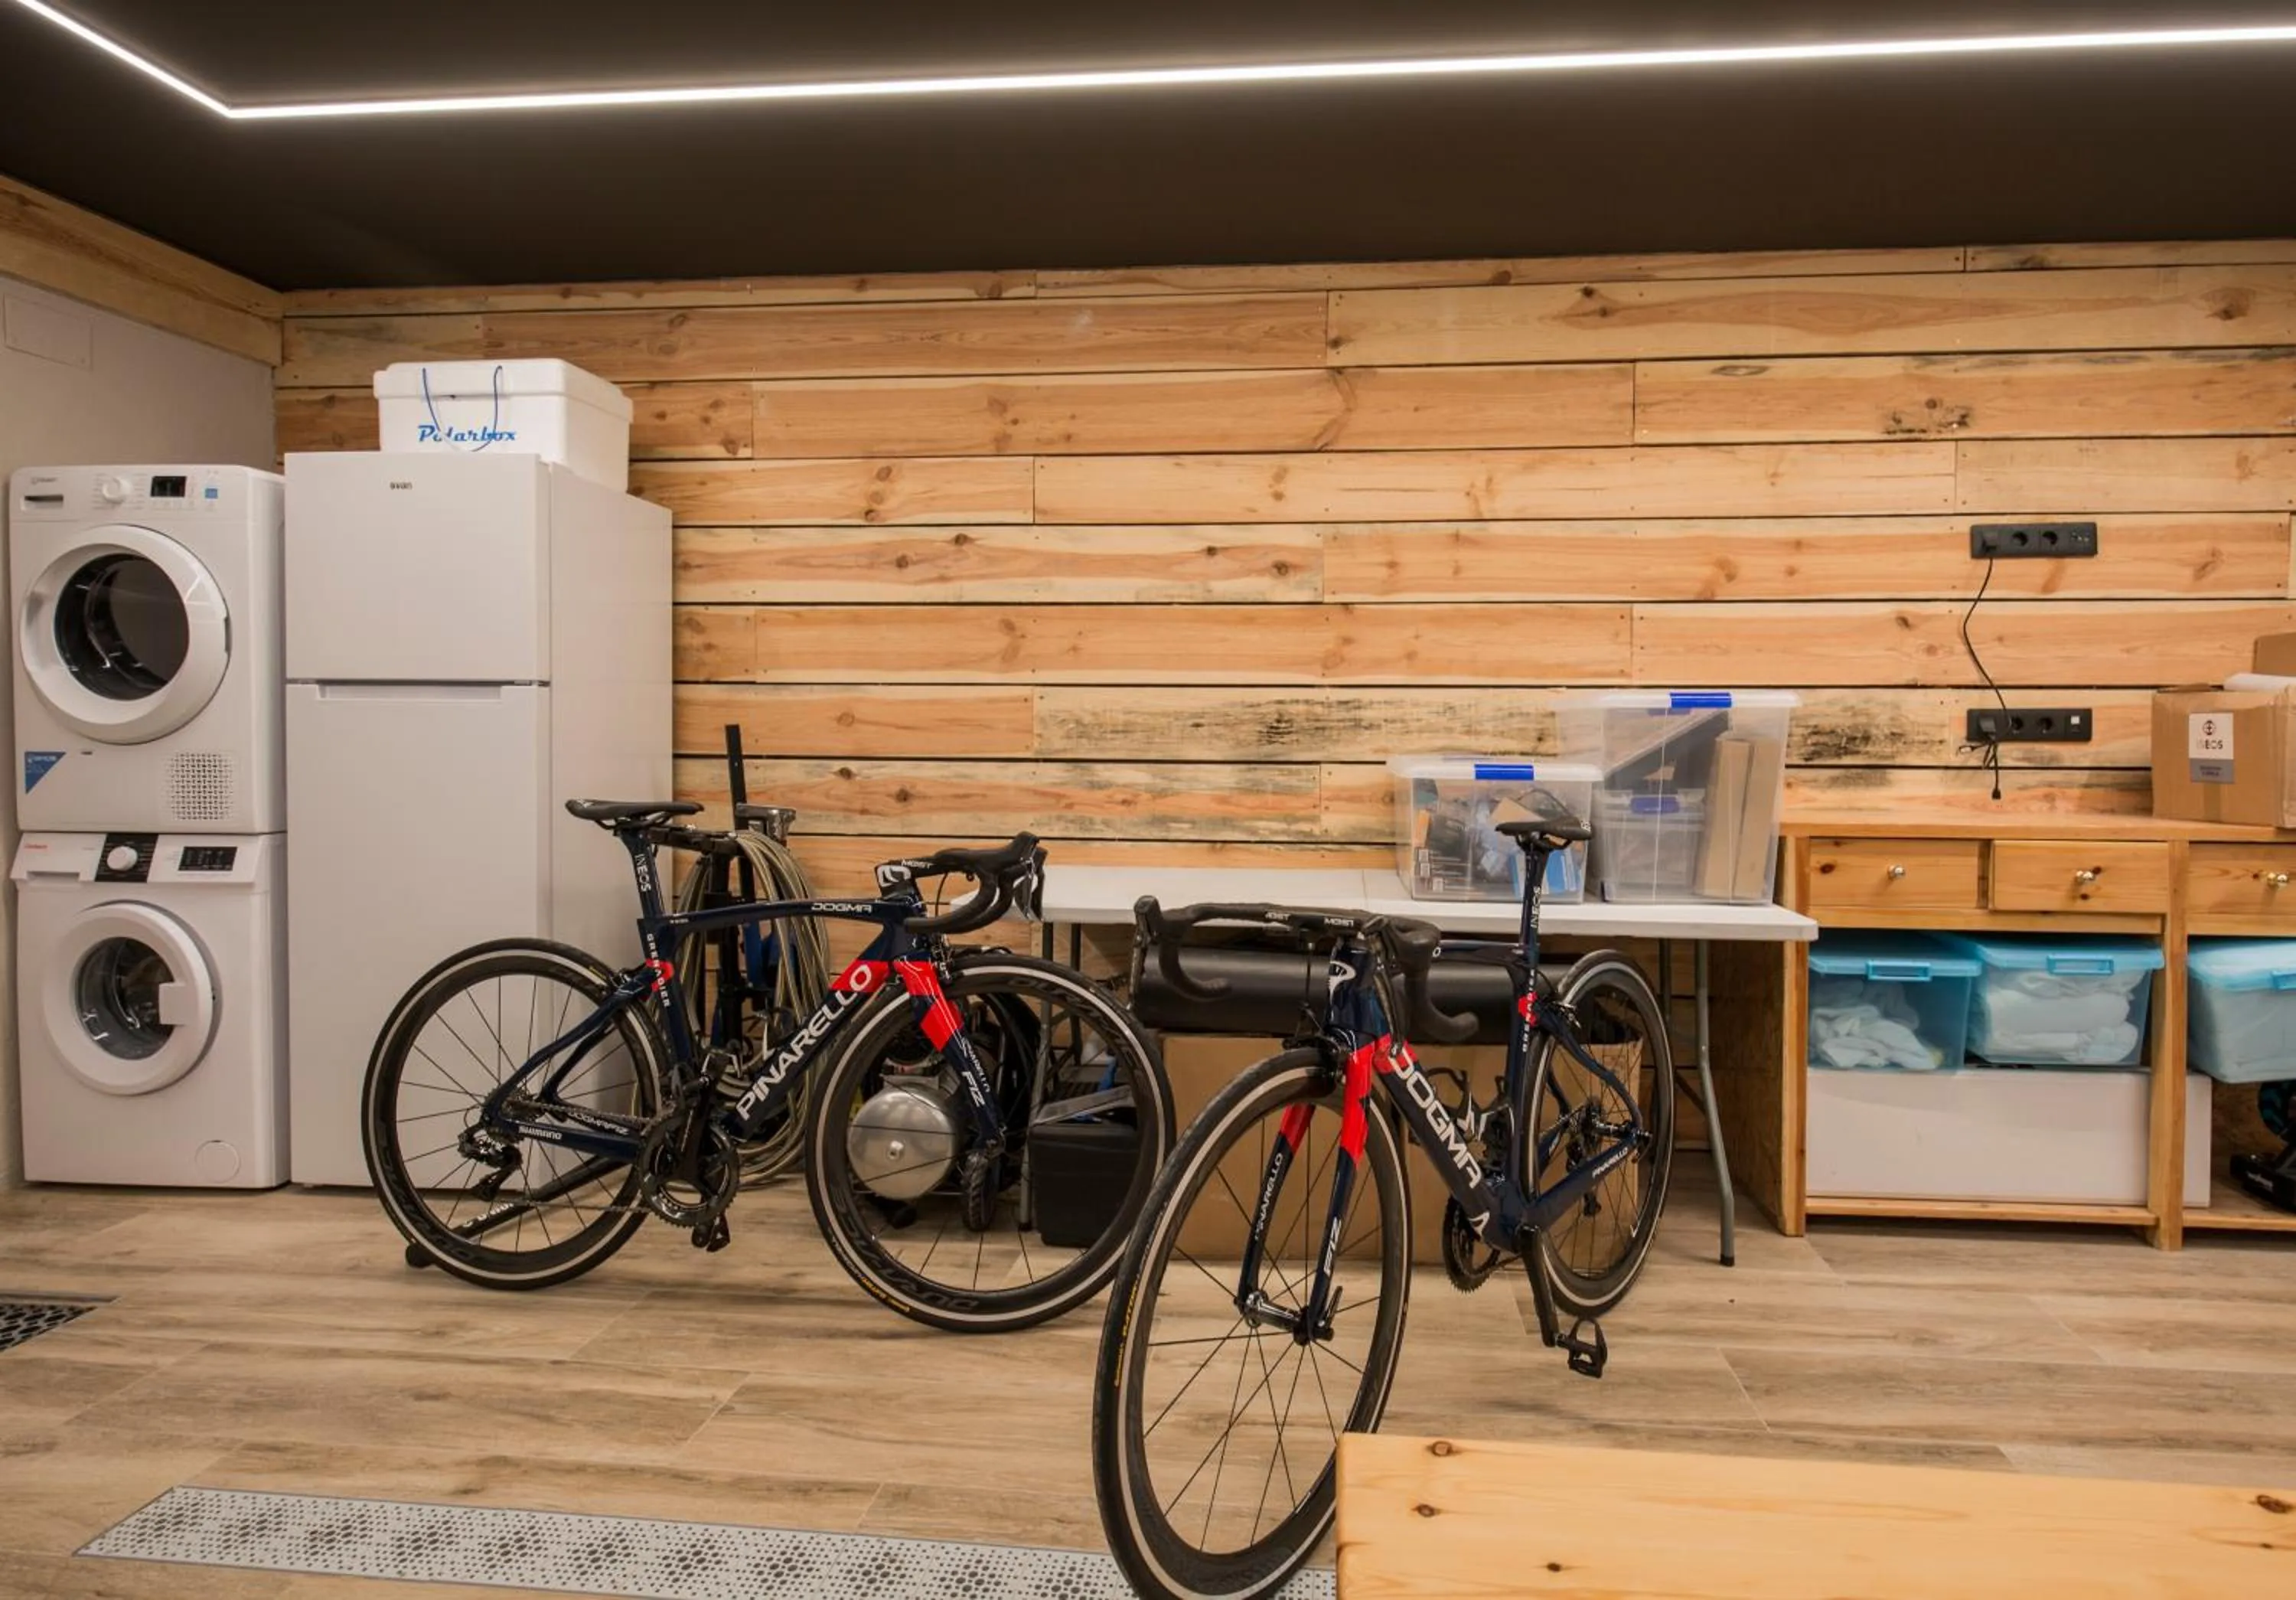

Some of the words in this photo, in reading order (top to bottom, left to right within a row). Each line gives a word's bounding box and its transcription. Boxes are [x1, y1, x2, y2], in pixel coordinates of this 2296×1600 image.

[634, 854, 651, 893] INEOS
[811, 902, 872, 914] DOGMA
[735, 964, 872, 1122] PINARELLO
[1388, 1046, 1482, 1189] DOGMA
